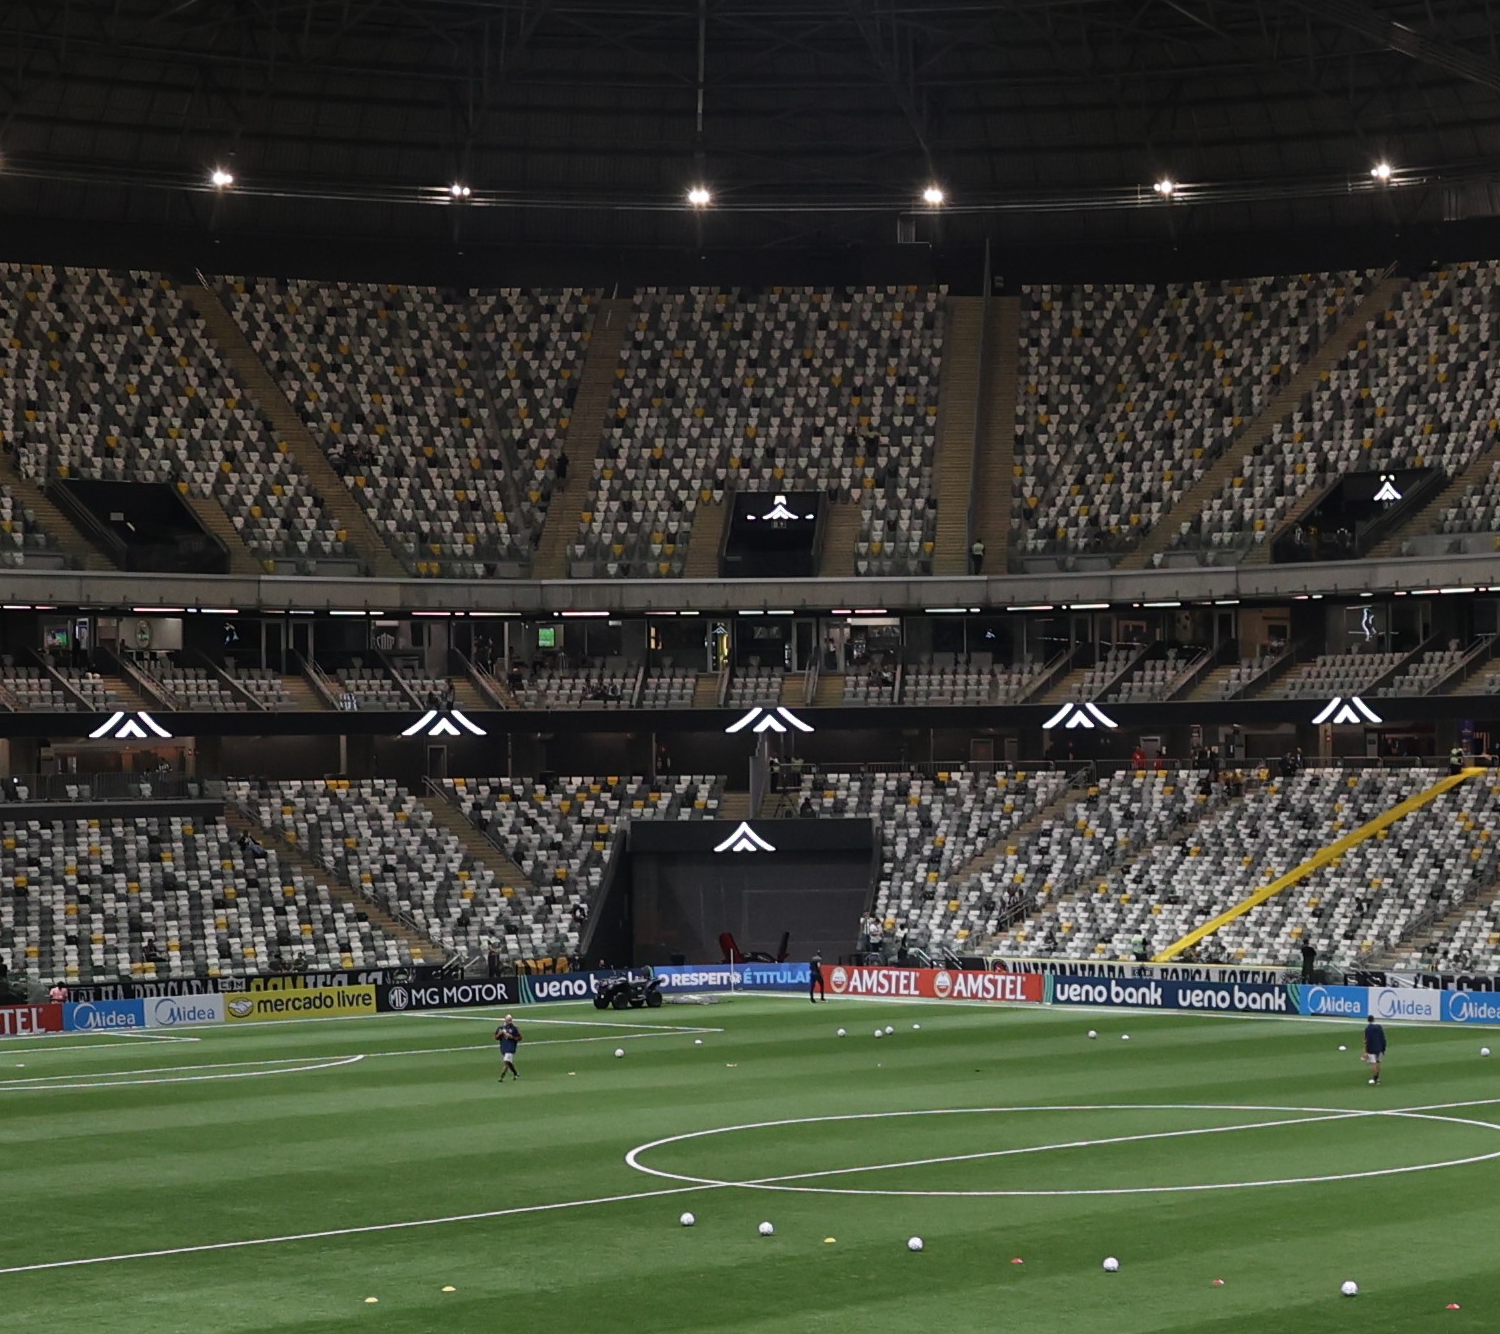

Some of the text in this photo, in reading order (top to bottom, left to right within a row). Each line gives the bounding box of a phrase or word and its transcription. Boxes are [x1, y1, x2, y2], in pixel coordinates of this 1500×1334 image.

[743, 966, 752, 984] É
[850, 969, 920, 995] AMSTEL
[411, 983, 508, 1005] MG MOTOR
[535, 977, 589, 998] ueno
[953, 973, 1026, 1001] AMSTEL
[1057, 979, 1162, 1005] ueno bank
[1178, 984, 1286, 1011] ueno bank
[166, 1001, 215, 1023] Midea
[257, 989, 372, 1013] mercado livre
[1318, 994, 1361, 1014] Midea
[1390, 994, 1432, 1016] Midea
[87, 1009, 135, 1029] Midea
